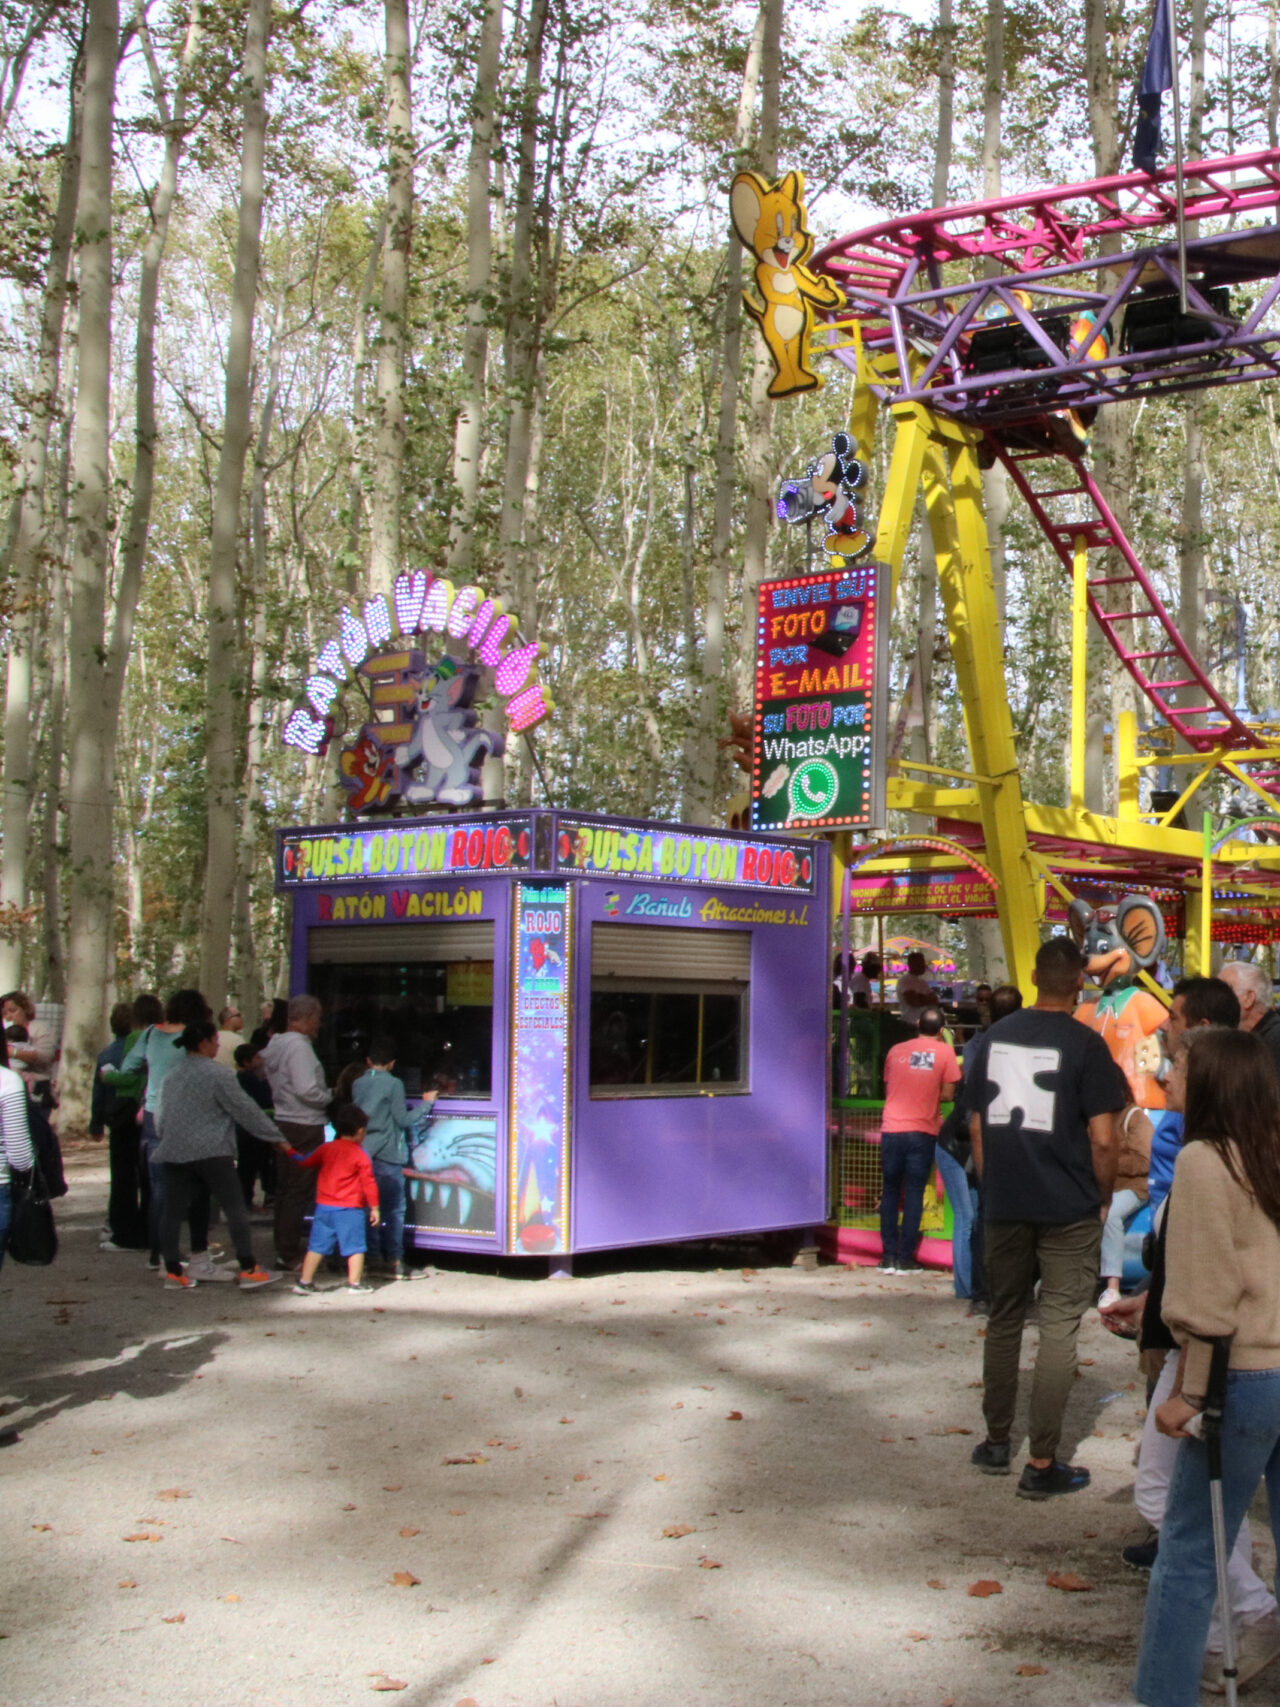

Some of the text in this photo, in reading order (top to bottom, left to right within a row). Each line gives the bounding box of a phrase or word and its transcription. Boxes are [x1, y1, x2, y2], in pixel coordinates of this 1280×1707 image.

[772, 577, 866, 609] ENVIE SU
[770, 609, 826, 639] FOTO
[769, 644, 809, 666] POR
[770, 663, 865, 697] E-MAIL
[763, 702, 866, 735] SU FOTO POR
[763, 732, 866, 761] WhatsApp
[297, 835, 364, 878] PULSA
[450, 825, 512, 868] ROJO
[574, 827, 653, 873] PULSA
[742, 846, 796, 886] ROJO
[318, 886, 483, 920] RATÓN VACILÓN
[624, 893, 692, 919] Bañuls
[699, 897, 787, 925] Atracciones
[525, 910, 562, 935] ROJO
